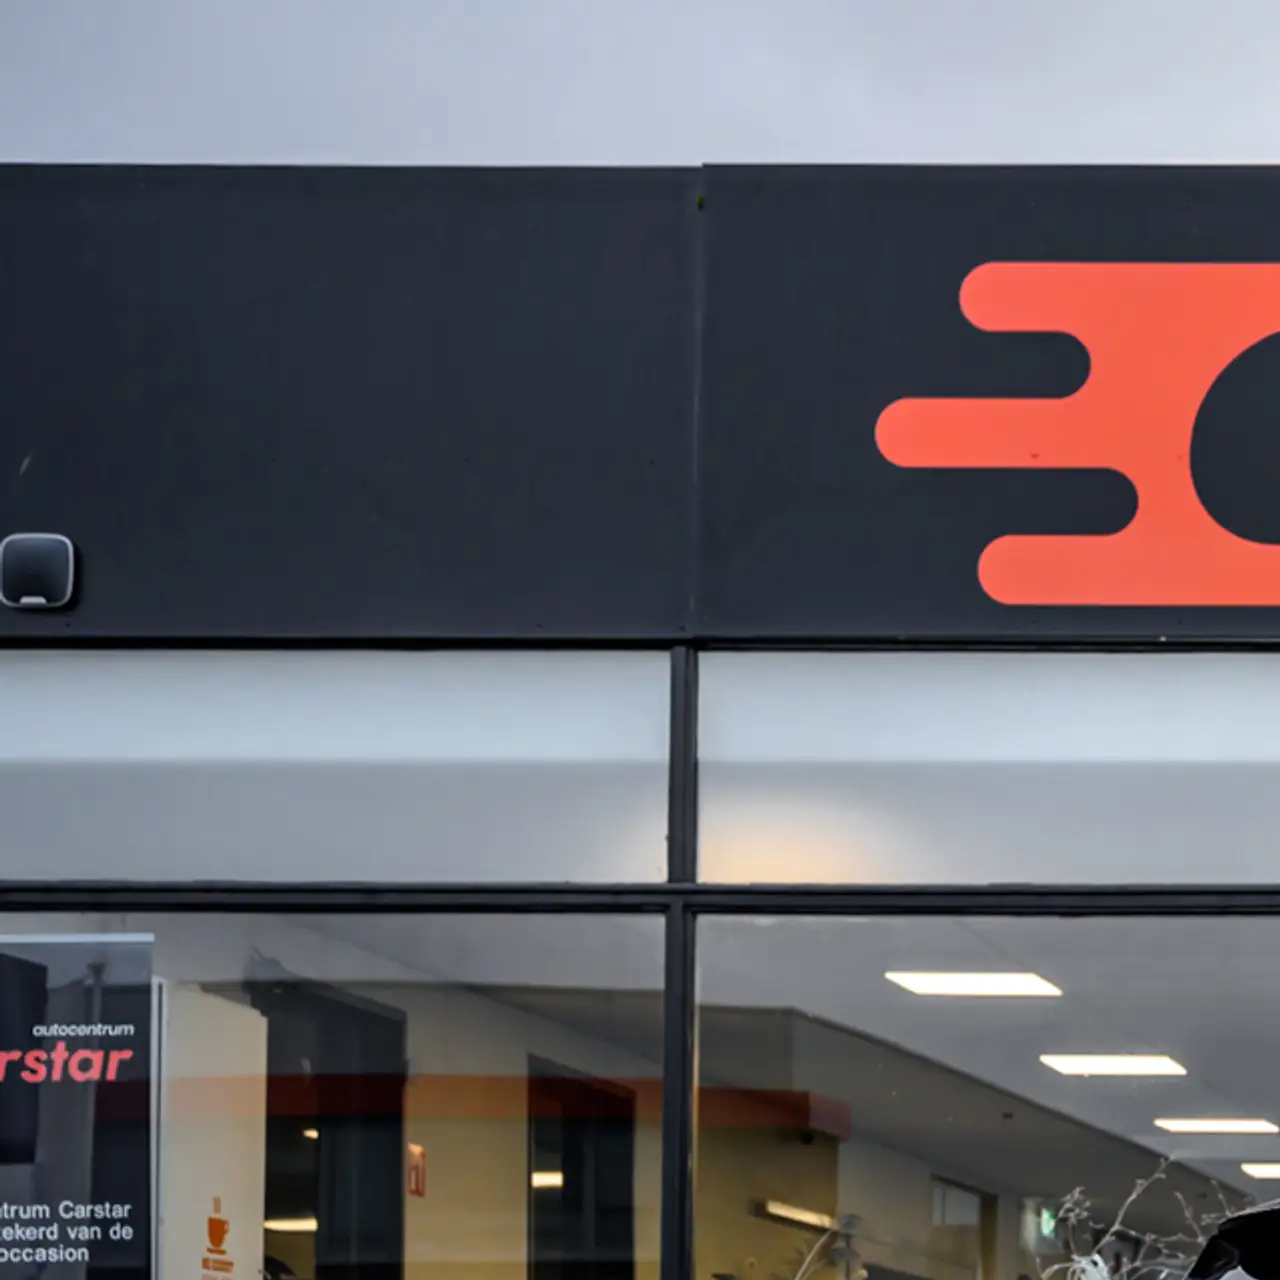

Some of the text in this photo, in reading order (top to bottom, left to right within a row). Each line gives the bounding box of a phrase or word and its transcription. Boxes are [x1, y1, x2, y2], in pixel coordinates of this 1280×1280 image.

[32, 1023, 135, 1037] autocentrum
[0, 1200, 132, 1219] trum Carstar
[0, 1222, 134, 1240] ekerd van de
[0, 1244, 90, 1262] occasion
